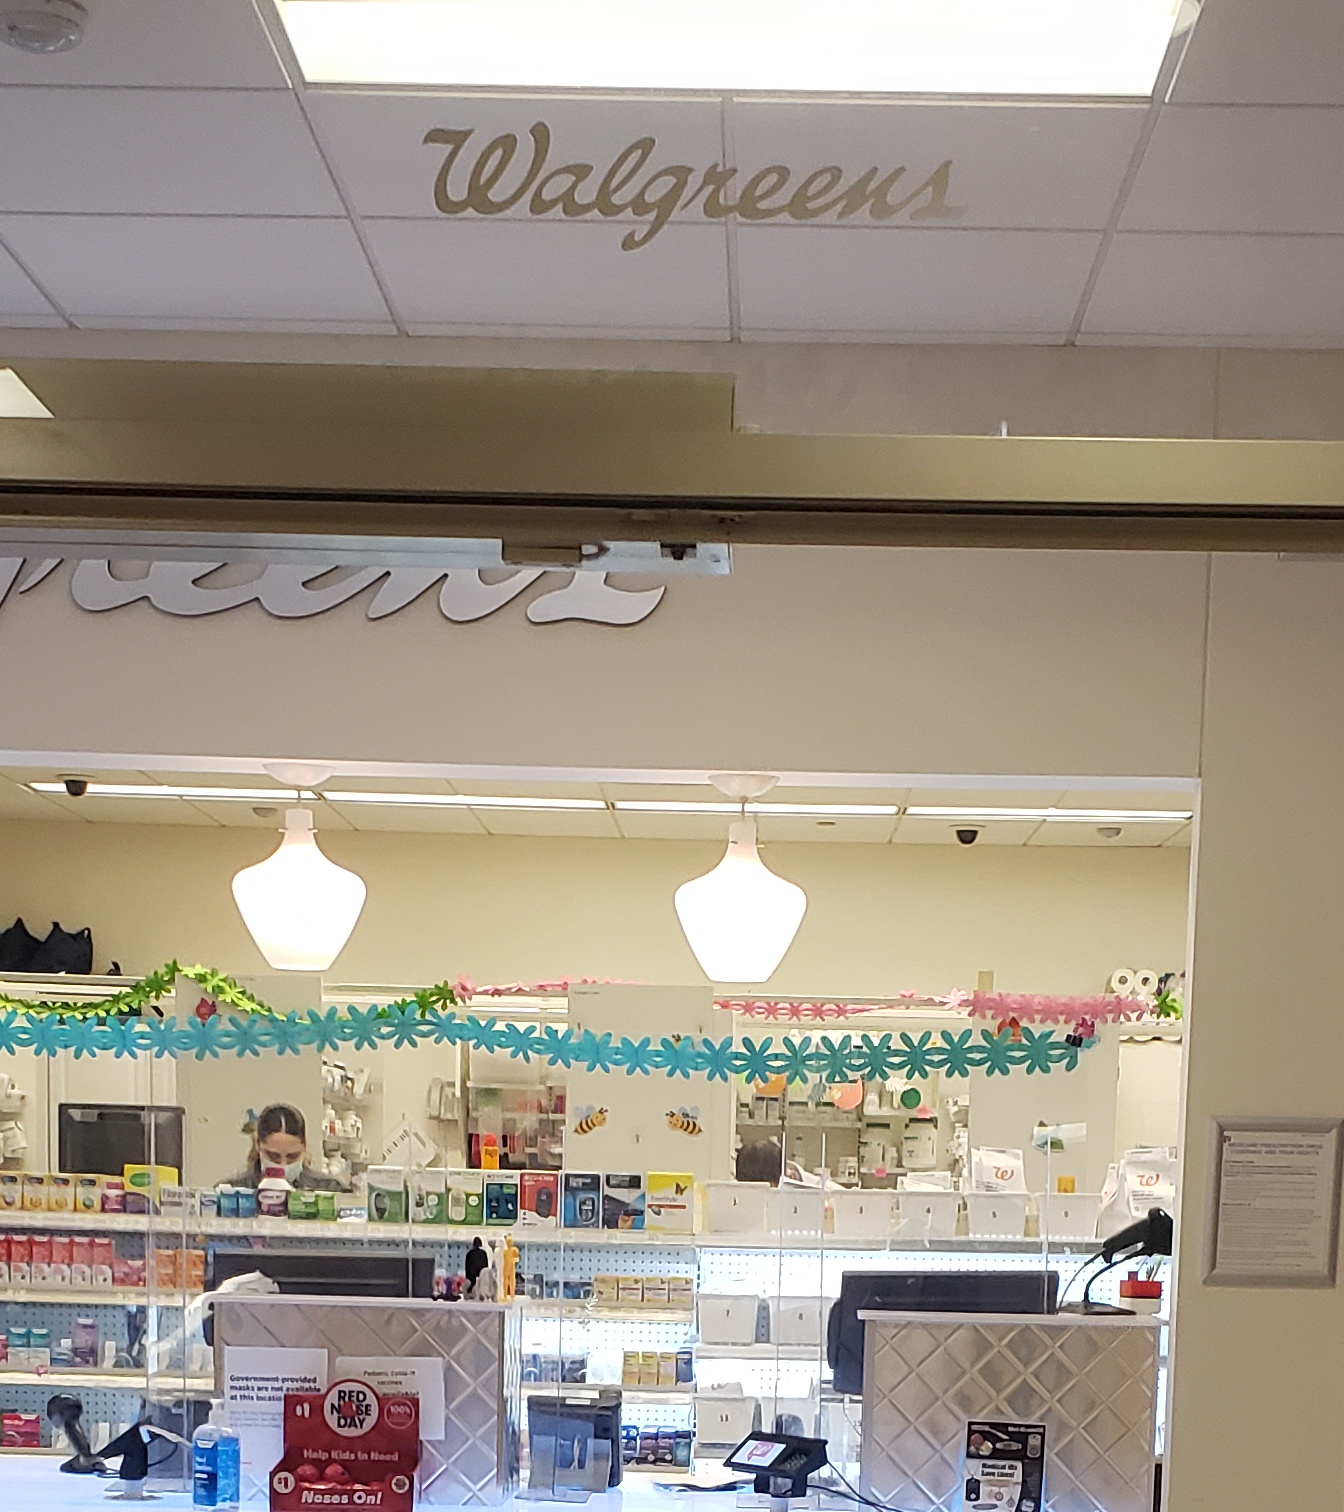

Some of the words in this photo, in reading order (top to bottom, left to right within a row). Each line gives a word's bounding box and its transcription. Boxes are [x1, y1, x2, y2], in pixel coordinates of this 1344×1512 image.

[423, 121, 967, 251] Walgreens
[229, 1375, 317, 1384] Government-provided
[229, 1384, 255, 1393] masks
[256, 1385, 269, 1393] are
[270, 1385, 284, 1393] not
[285, 1385, 321, 1394] available
[229, 1393, 239, 1401] at
[240, 1393, 255, 1401] this
[256, 1393, 284, 1402] locatio
[338, 1389, 367, 1403] RED
[337, 1416, 367, 1430] DAY
[304, 1449, 328, 1461] Help
[331, 1449, 356, 1461] Kids
[370, 1450, 399, 1461] Need
[302, 1490, 349, 1504] Noses
[353, 1490, 383, 1506] On!
